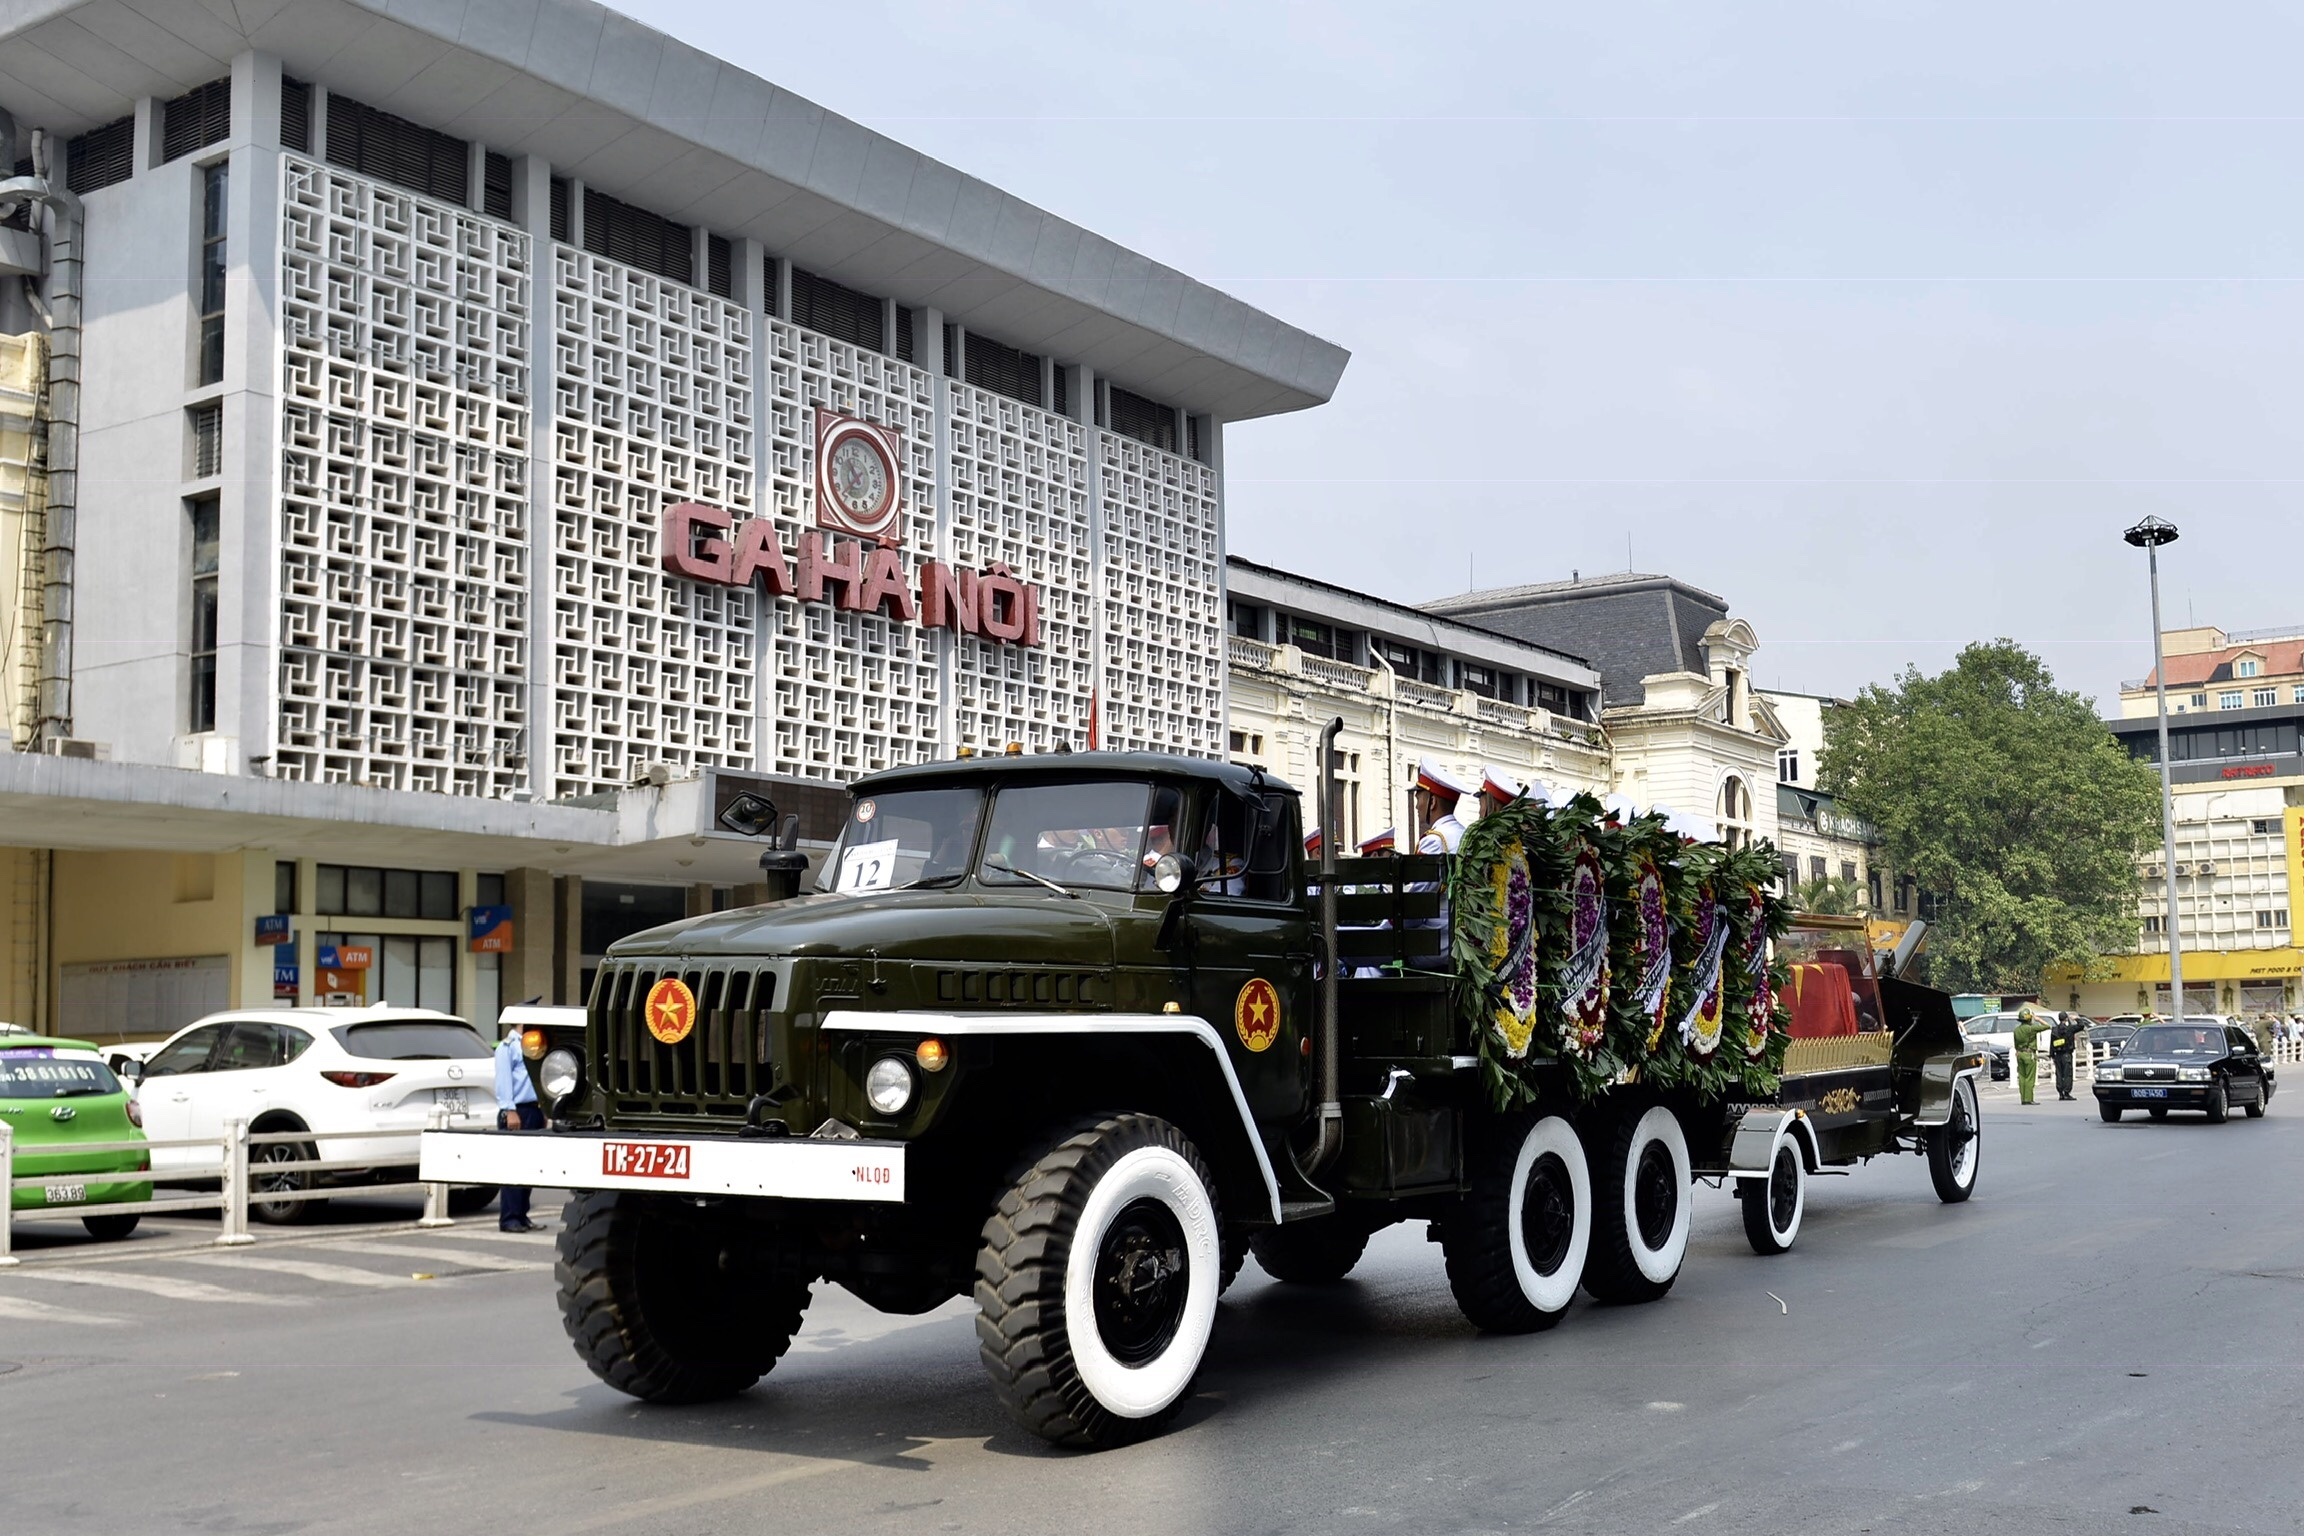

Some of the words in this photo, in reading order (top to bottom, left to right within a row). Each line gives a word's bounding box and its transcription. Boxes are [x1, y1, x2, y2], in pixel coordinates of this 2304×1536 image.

[662, 502, 794, 596] GA
[797, 532, 916, 621] HÀ
[861, 804, 872, 813] 10
[853, 860, 881, 888] 12
[264, 918, 283, 931] ATM
[345, 952, 368, 963] ATM
